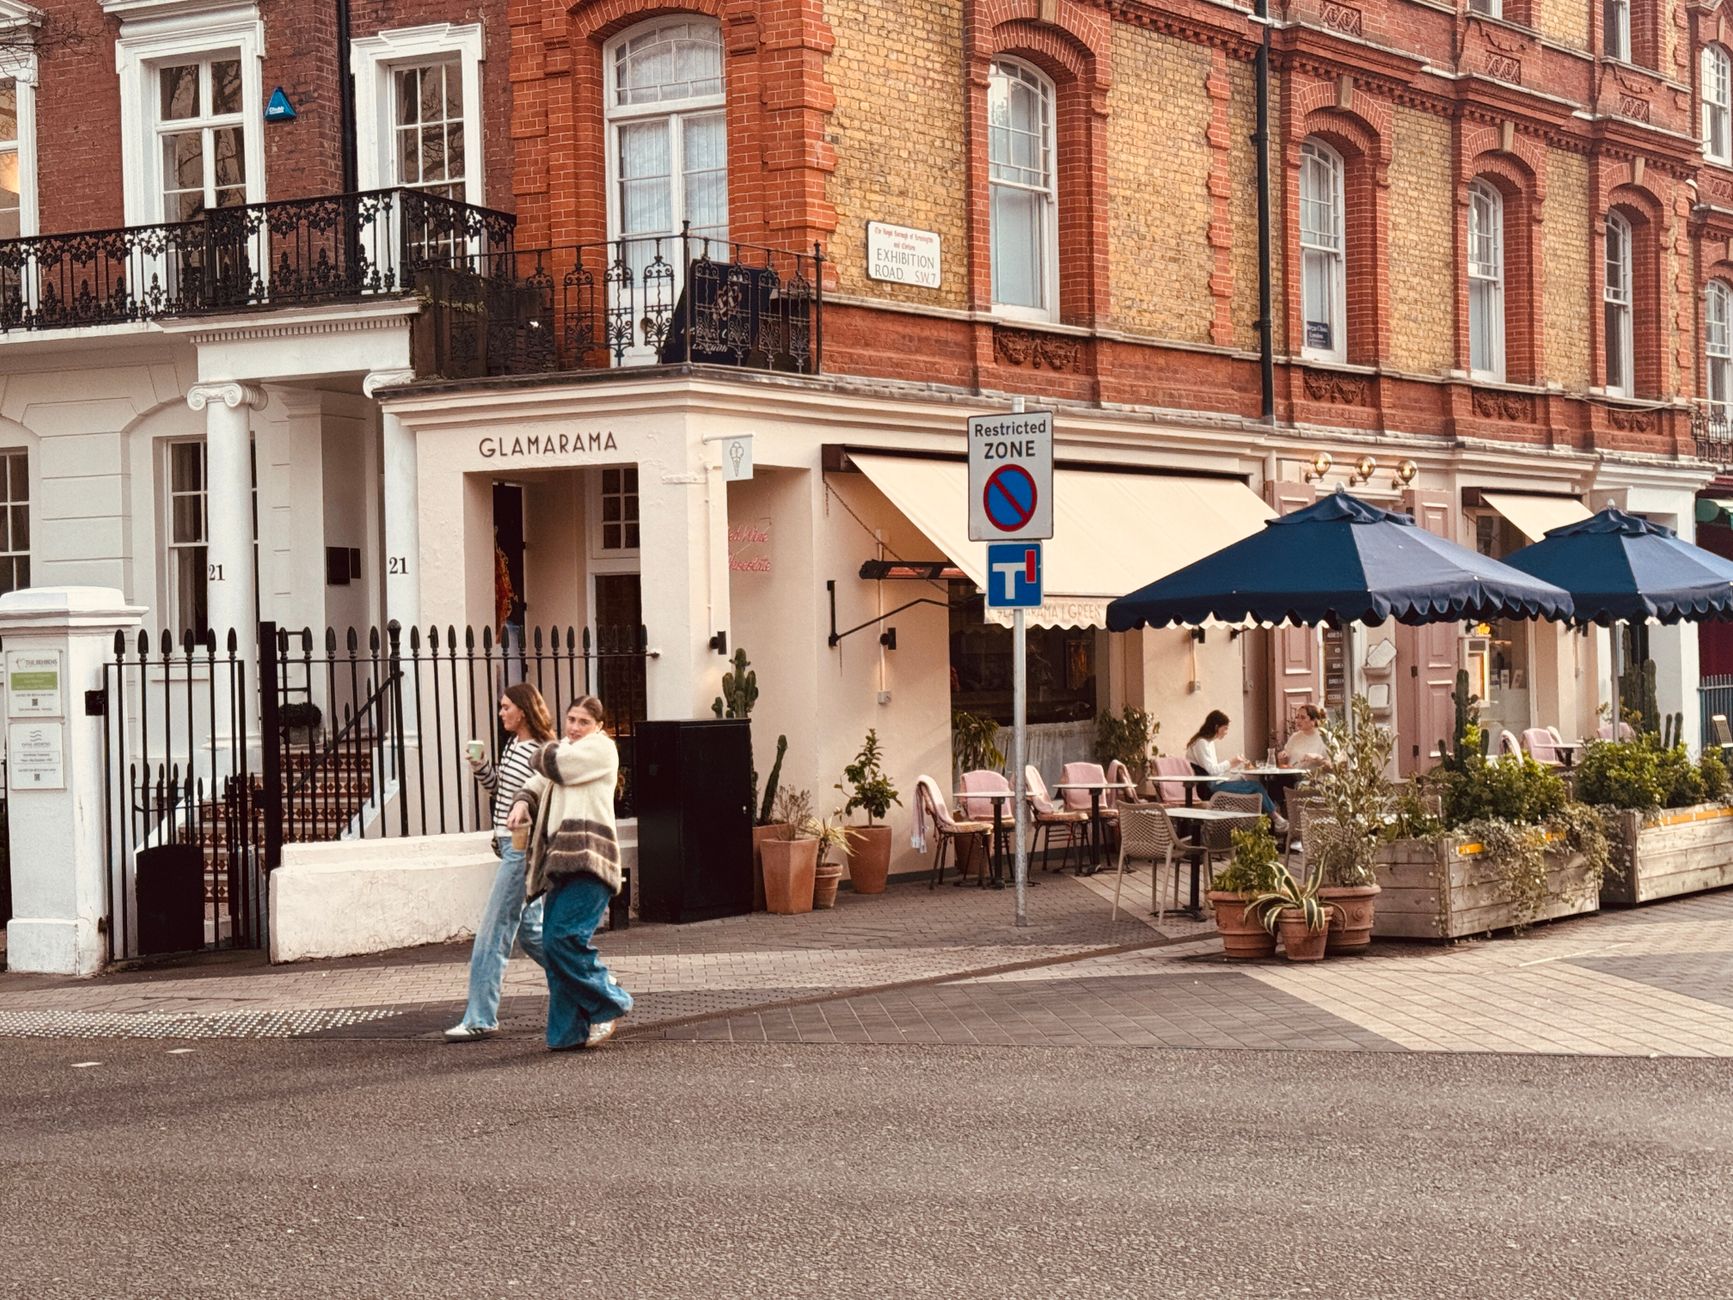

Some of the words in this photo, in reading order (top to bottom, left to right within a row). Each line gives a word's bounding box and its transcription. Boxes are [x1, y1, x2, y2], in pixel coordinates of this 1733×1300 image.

[877, 248, 934, 269] EXHIBITION
[975, 419, 1046, 437] Restricted
[479, 431, 618, 458] GLAMARAMA
[984, 440, 1036, 459] ZONE
[209, 564, 225, 581] 21
[389, 556, 409, 574] 21
